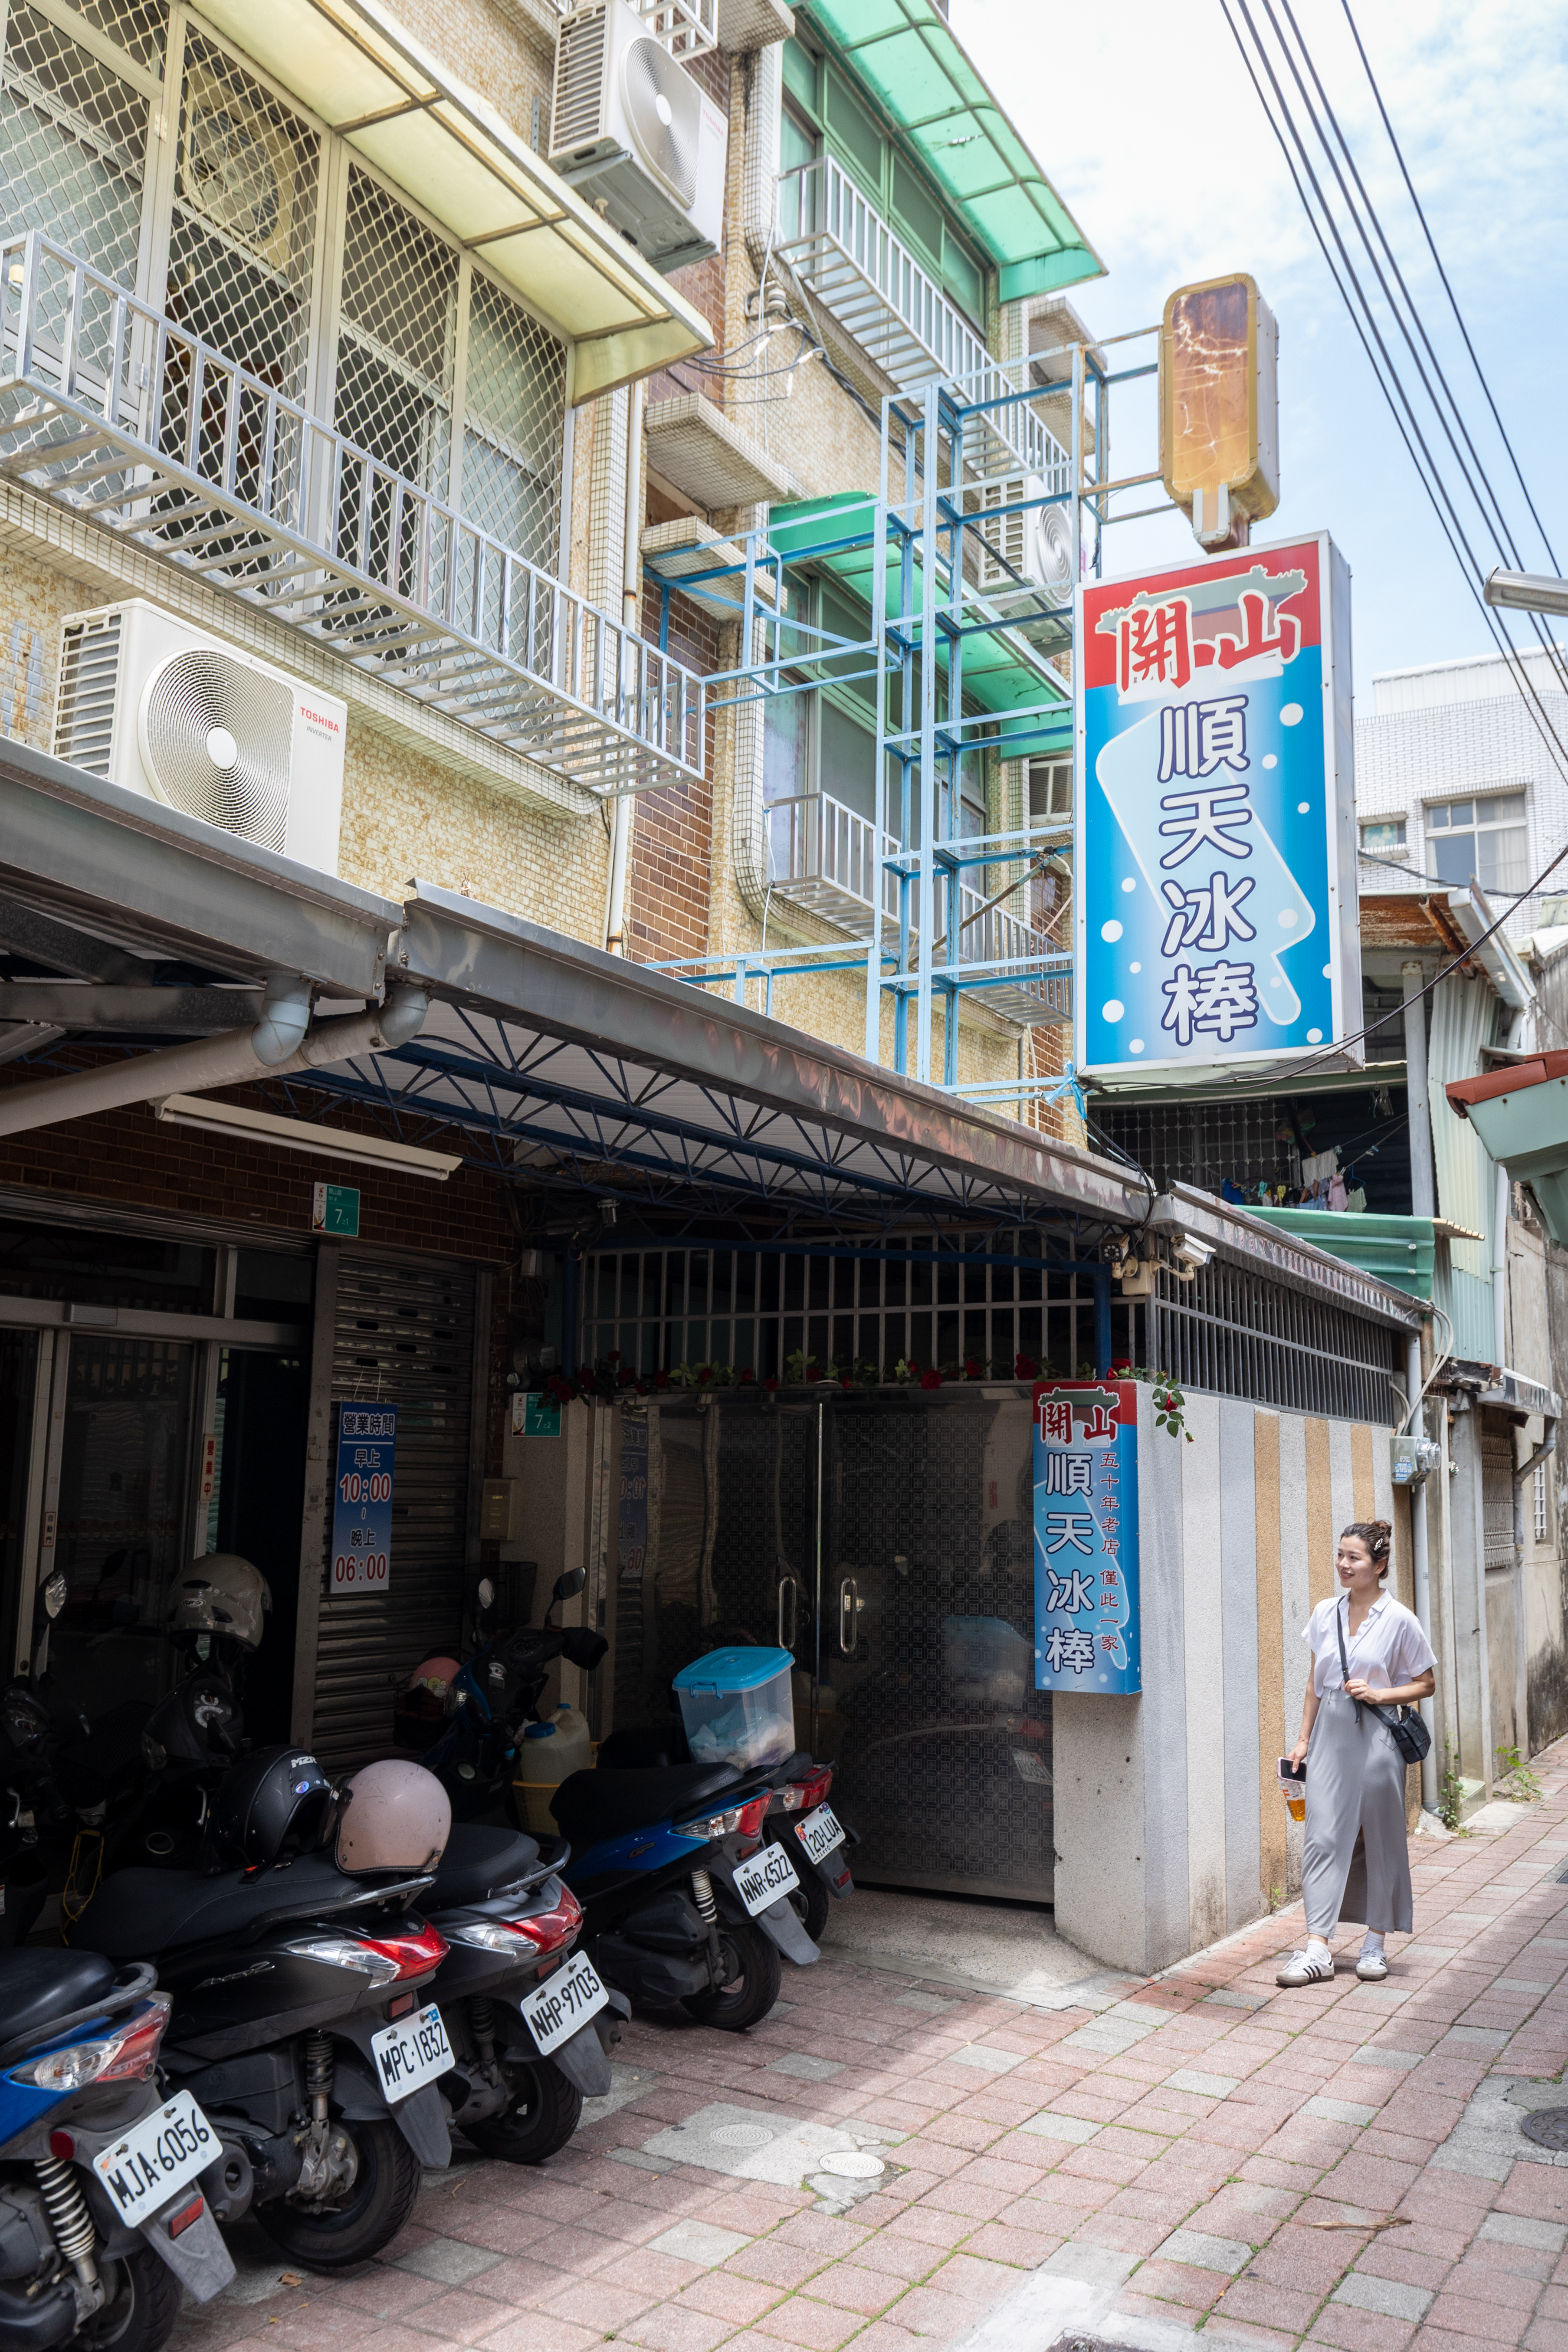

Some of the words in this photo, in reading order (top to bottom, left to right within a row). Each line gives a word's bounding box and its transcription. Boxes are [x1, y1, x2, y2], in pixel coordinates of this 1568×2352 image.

[1118, 589, 1300, 695] 開山
[300, 706, 339, 734] TOSHIBA
[306, 725, 332, 742] INVERTER
[1158, 694, 1259, 1046] 順天冰棒
[343, 1412, 395, 1436] 營業時間
[1041, 1401, 1117, 1446] 開山
[204, 1440, 214, 1496] 營業中
[354, 1448, 381, 1467] 早上
[340, 1473, 391, 1502] 10:00
[1100, 1452, 1119, 1556] 五十年老店
[351, 1528, 376, 1548] 晚上
[335, 1552, 387, 1582] 06:00
[1046, 1452, 1095, 1674] 順天冰棒
[1099, 1569, 1119, 1651] 僅此一家
[291, 1756, 318, 1768] MZR
